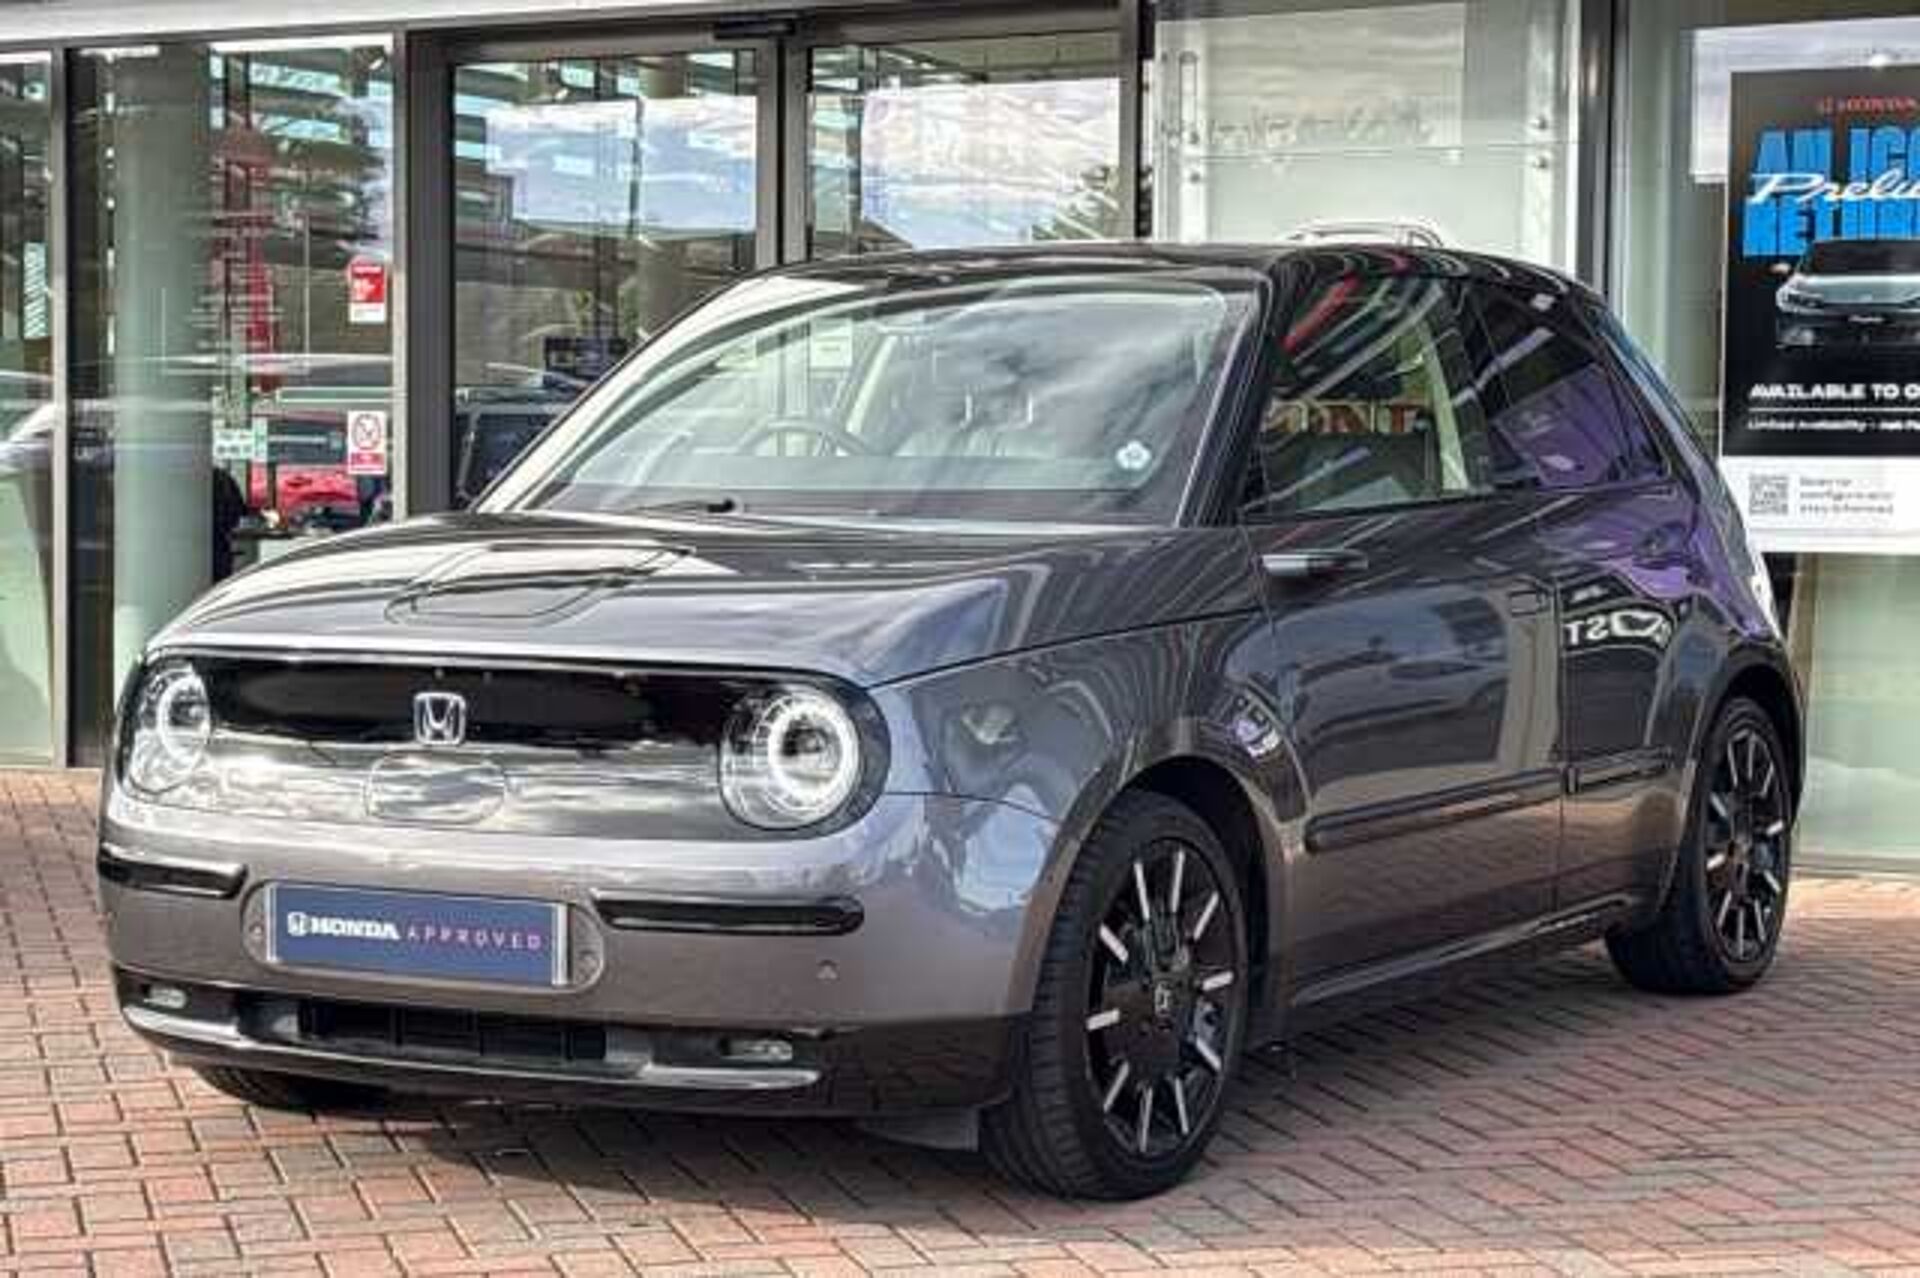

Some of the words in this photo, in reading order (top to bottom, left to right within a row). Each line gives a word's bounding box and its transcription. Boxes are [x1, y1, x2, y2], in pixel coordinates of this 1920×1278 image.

[1750, 383, 1866, 400] AVAILABLE
[1871, 383, 1900, 400] TO
[310, 917, 401, 940] HONDA
[407, 925, 541, 949] APPROVED
